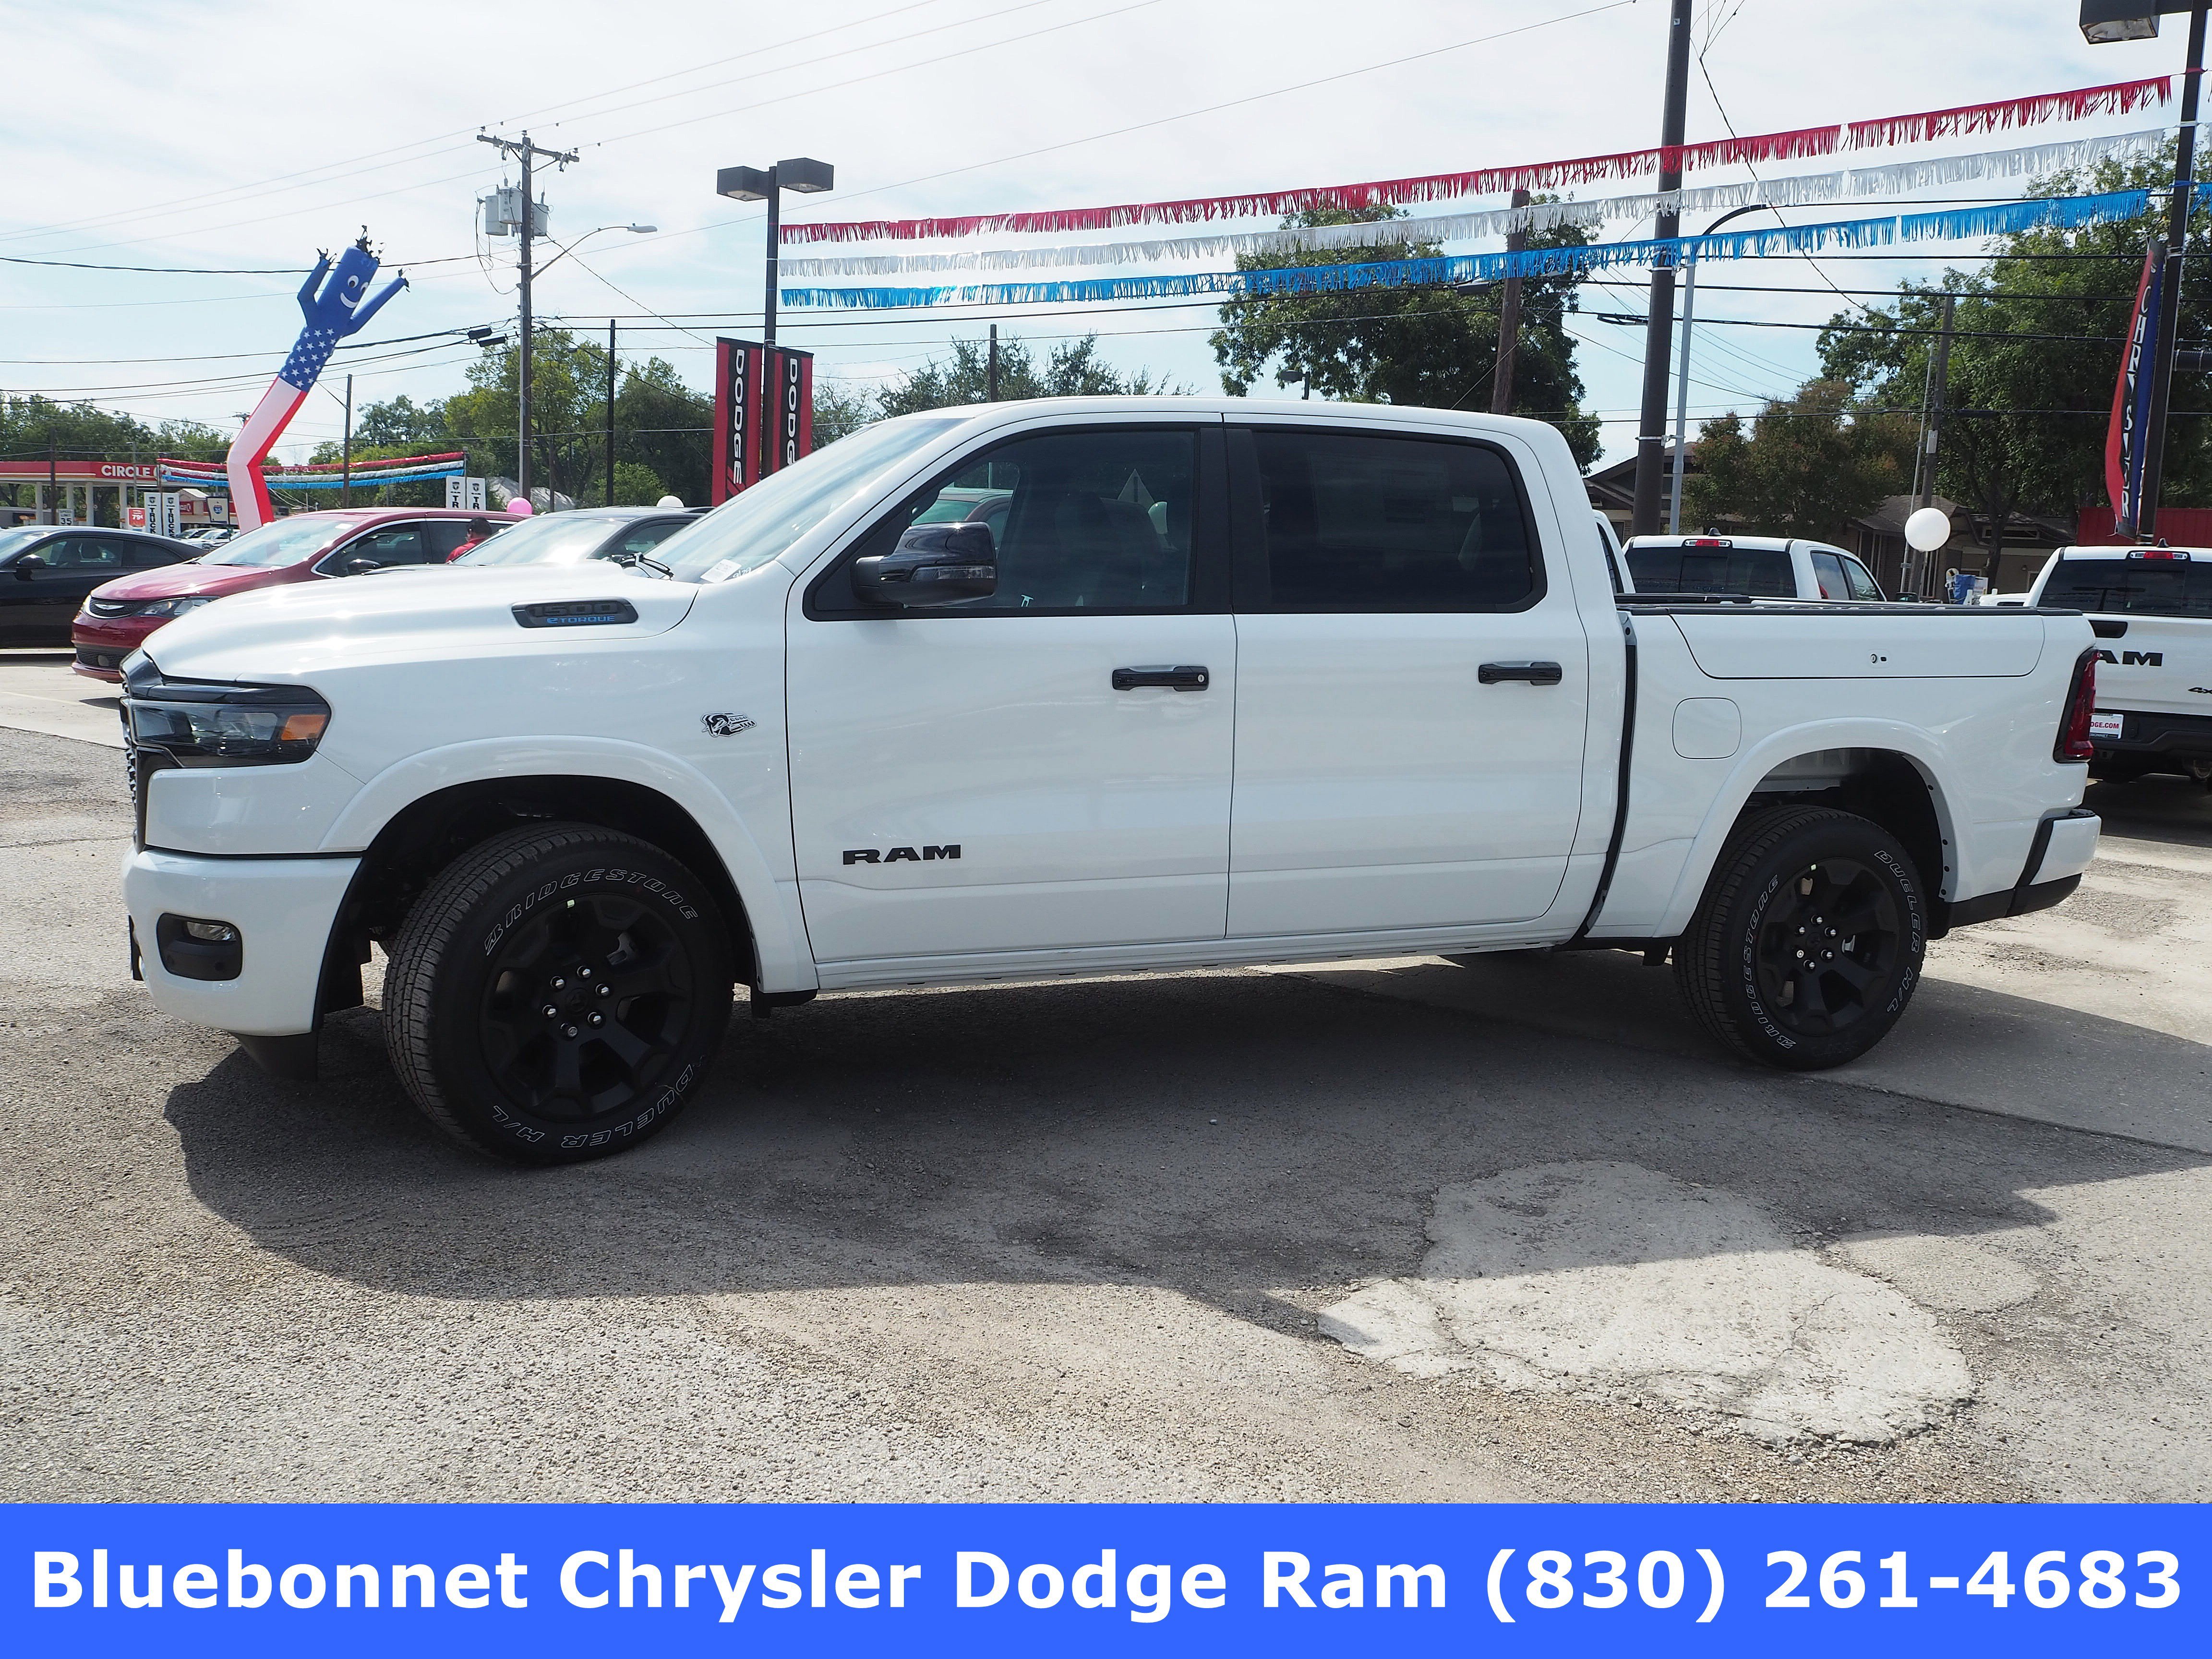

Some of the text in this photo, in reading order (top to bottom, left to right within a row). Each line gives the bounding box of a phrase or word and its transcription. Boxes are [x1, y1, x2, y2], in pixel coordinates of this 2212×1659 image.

[733, 349, 745, 484] DODGE
[787, 358, 797, 465] DODG
[101, 465, 150, 478] CIRCLE
[2098, 649, 2163, 667] AM
[842, 844, 961, 865] RAM
[484, 868, 699, 956] BRIDGESTONE
[1874, 850, 1921, 953] DUELER
[1743, 874, 1797, 1049] BRIDGESTONE
[493, 1064, 694, 1148] DUELER H/L
